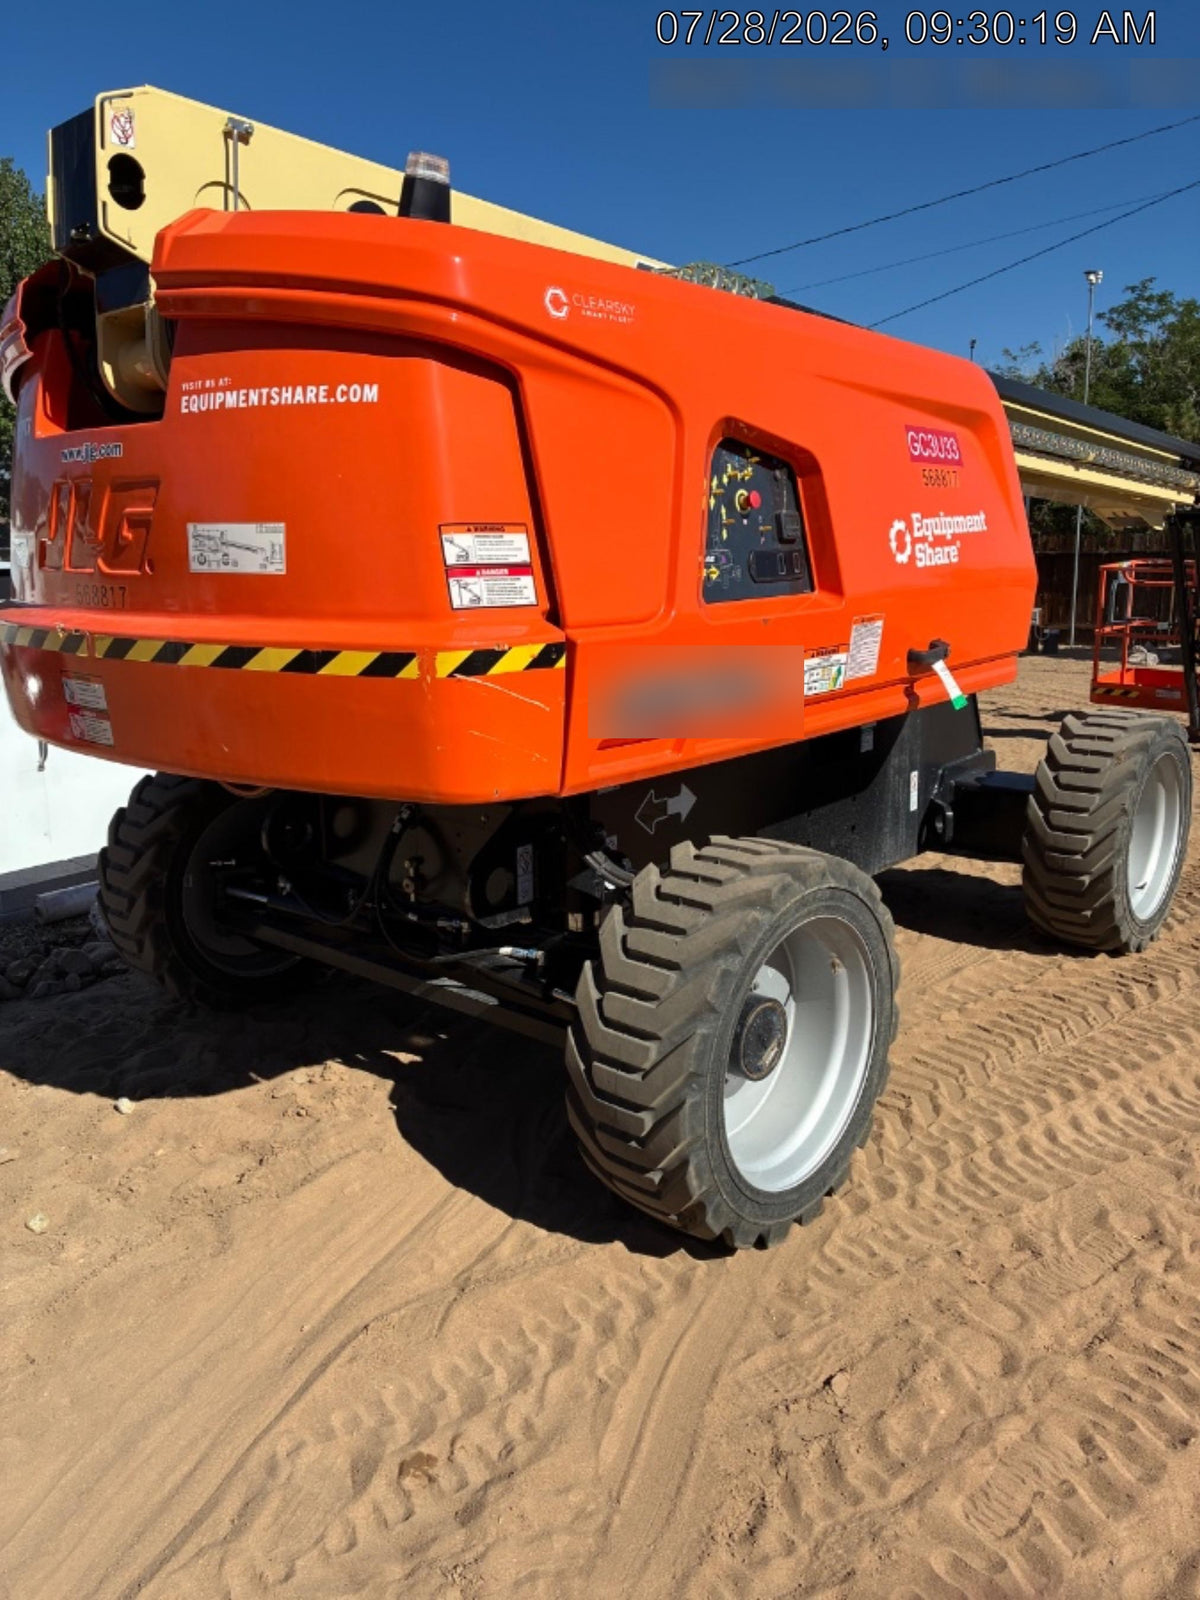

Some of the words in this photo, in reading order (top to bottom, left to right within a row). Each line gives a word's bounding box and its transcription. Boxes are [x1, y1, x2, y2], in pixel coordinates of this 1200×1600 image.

[572, 294, 636, 315] CLEARSKY
[181, 380, 202, 391] VISIT
[180, 384, 379, 413] EQUIPMENTSHARE.COM
[61, 442, 123, 464] www.jlg.com
[907, 431, 960, 460] GC3U33
[921, 468, 958, 488] 568817
[38, 475, 161, 576] JLG
[911, 510, 988, 541] Equipment
[75, 585, 127, 609] 568817
